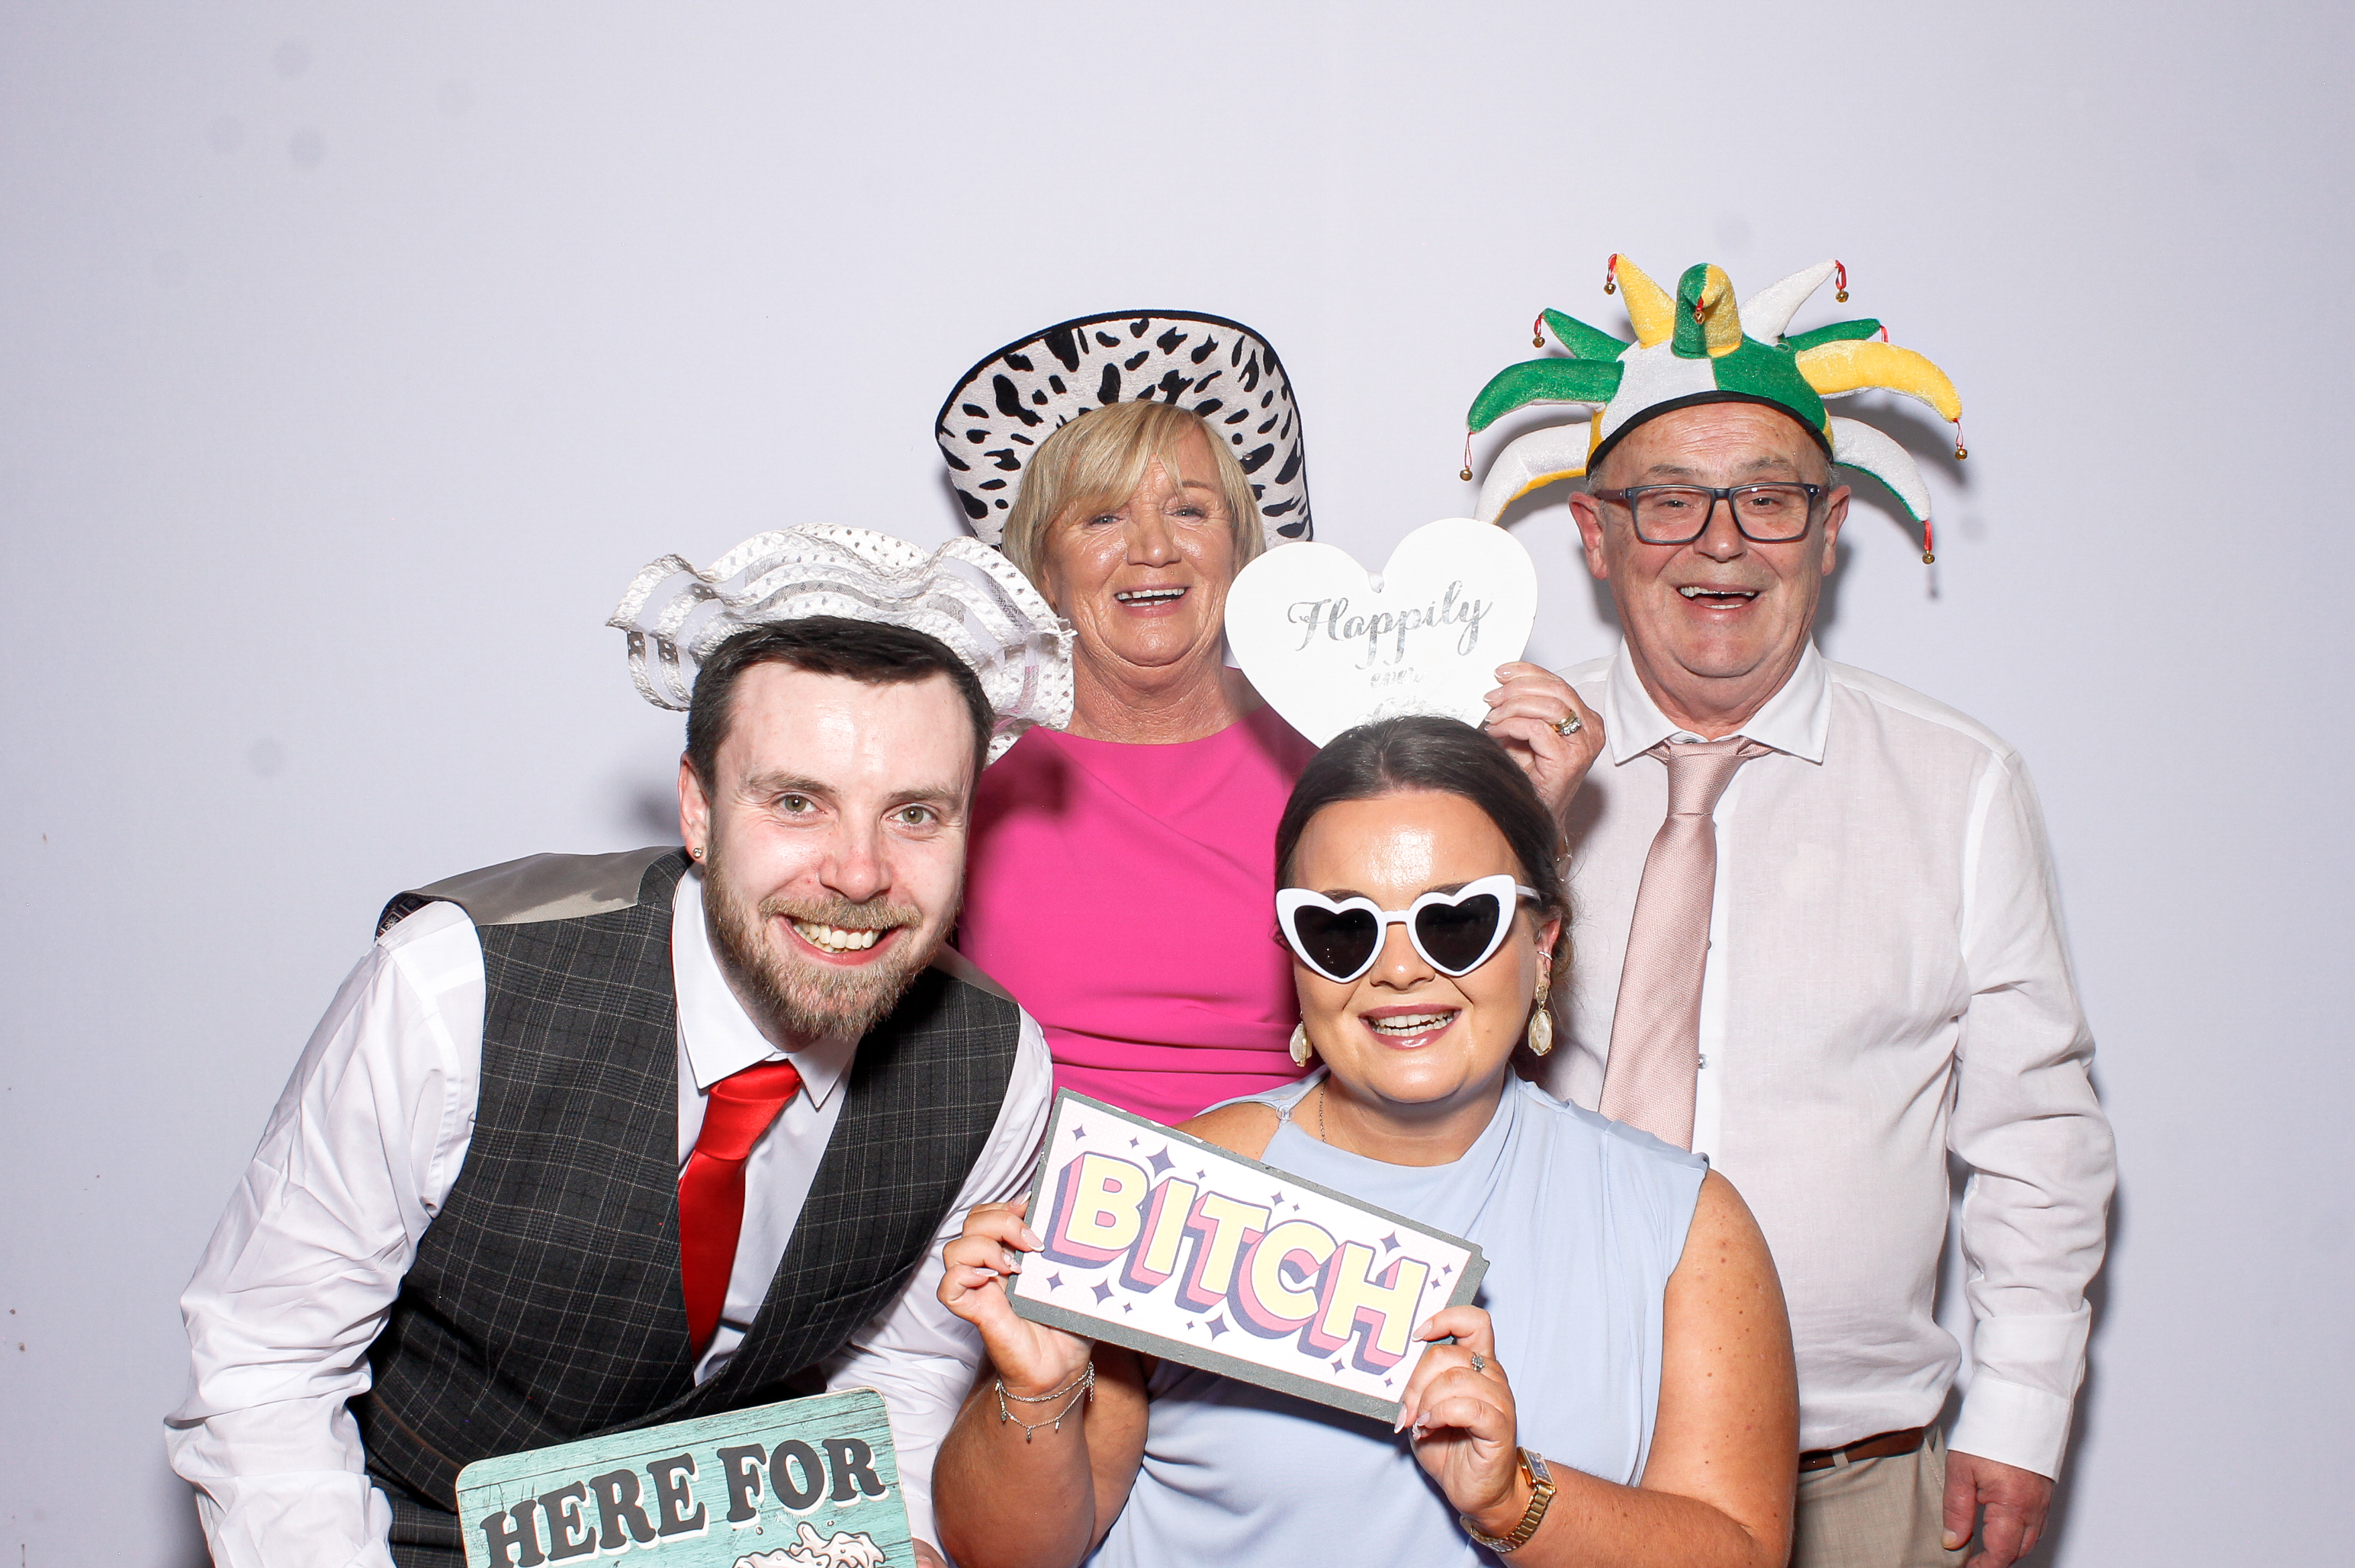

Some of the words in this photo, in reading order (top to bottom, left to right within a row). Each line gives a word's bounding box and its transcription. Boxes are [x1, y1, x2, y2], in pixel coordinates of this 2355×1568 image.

[1287, 580, 1493, 670] Happily
[1043, 1151, 1431, 1375] BITCH
[479, 1452, 709, 1568] HERE
[716, 1438, 889, 1529] FOR
